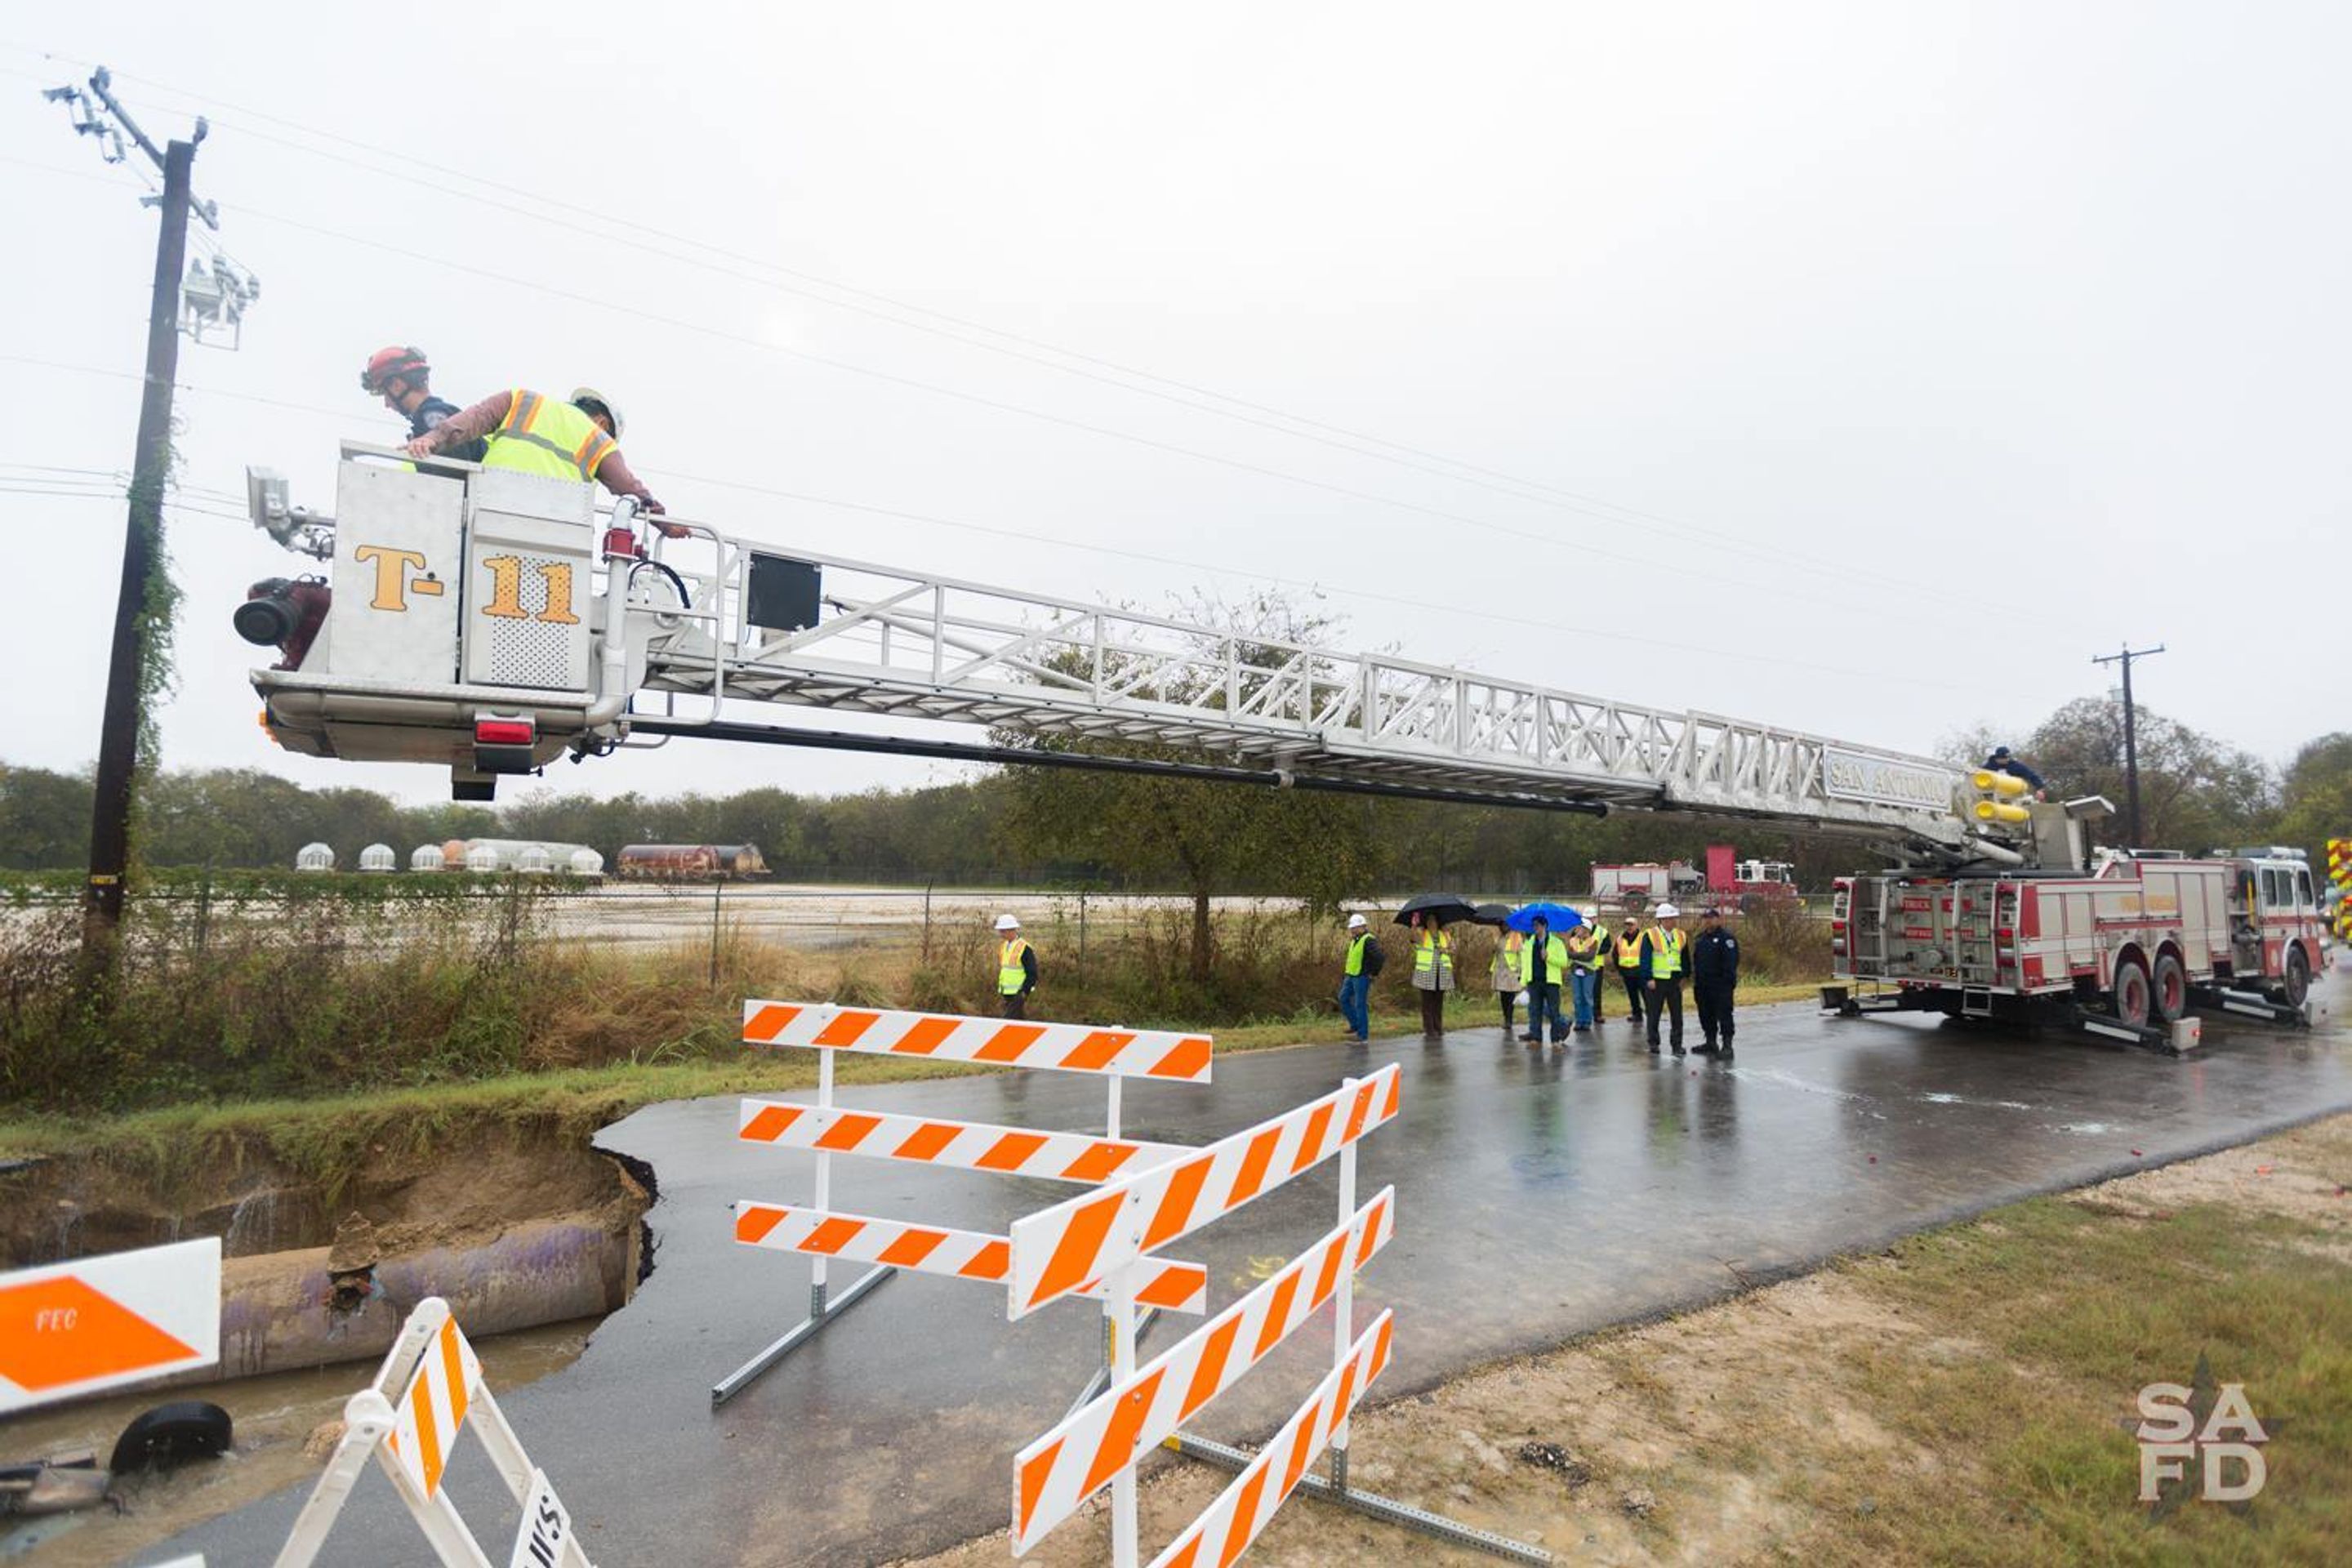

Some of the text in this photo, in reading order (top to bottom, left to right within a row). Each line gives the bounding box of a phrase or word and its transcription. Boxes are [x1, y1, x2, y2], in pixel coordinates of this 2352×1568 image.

[355, 545, 581, 624] T- 11
[1829, 760, 1865, 791] SAN
